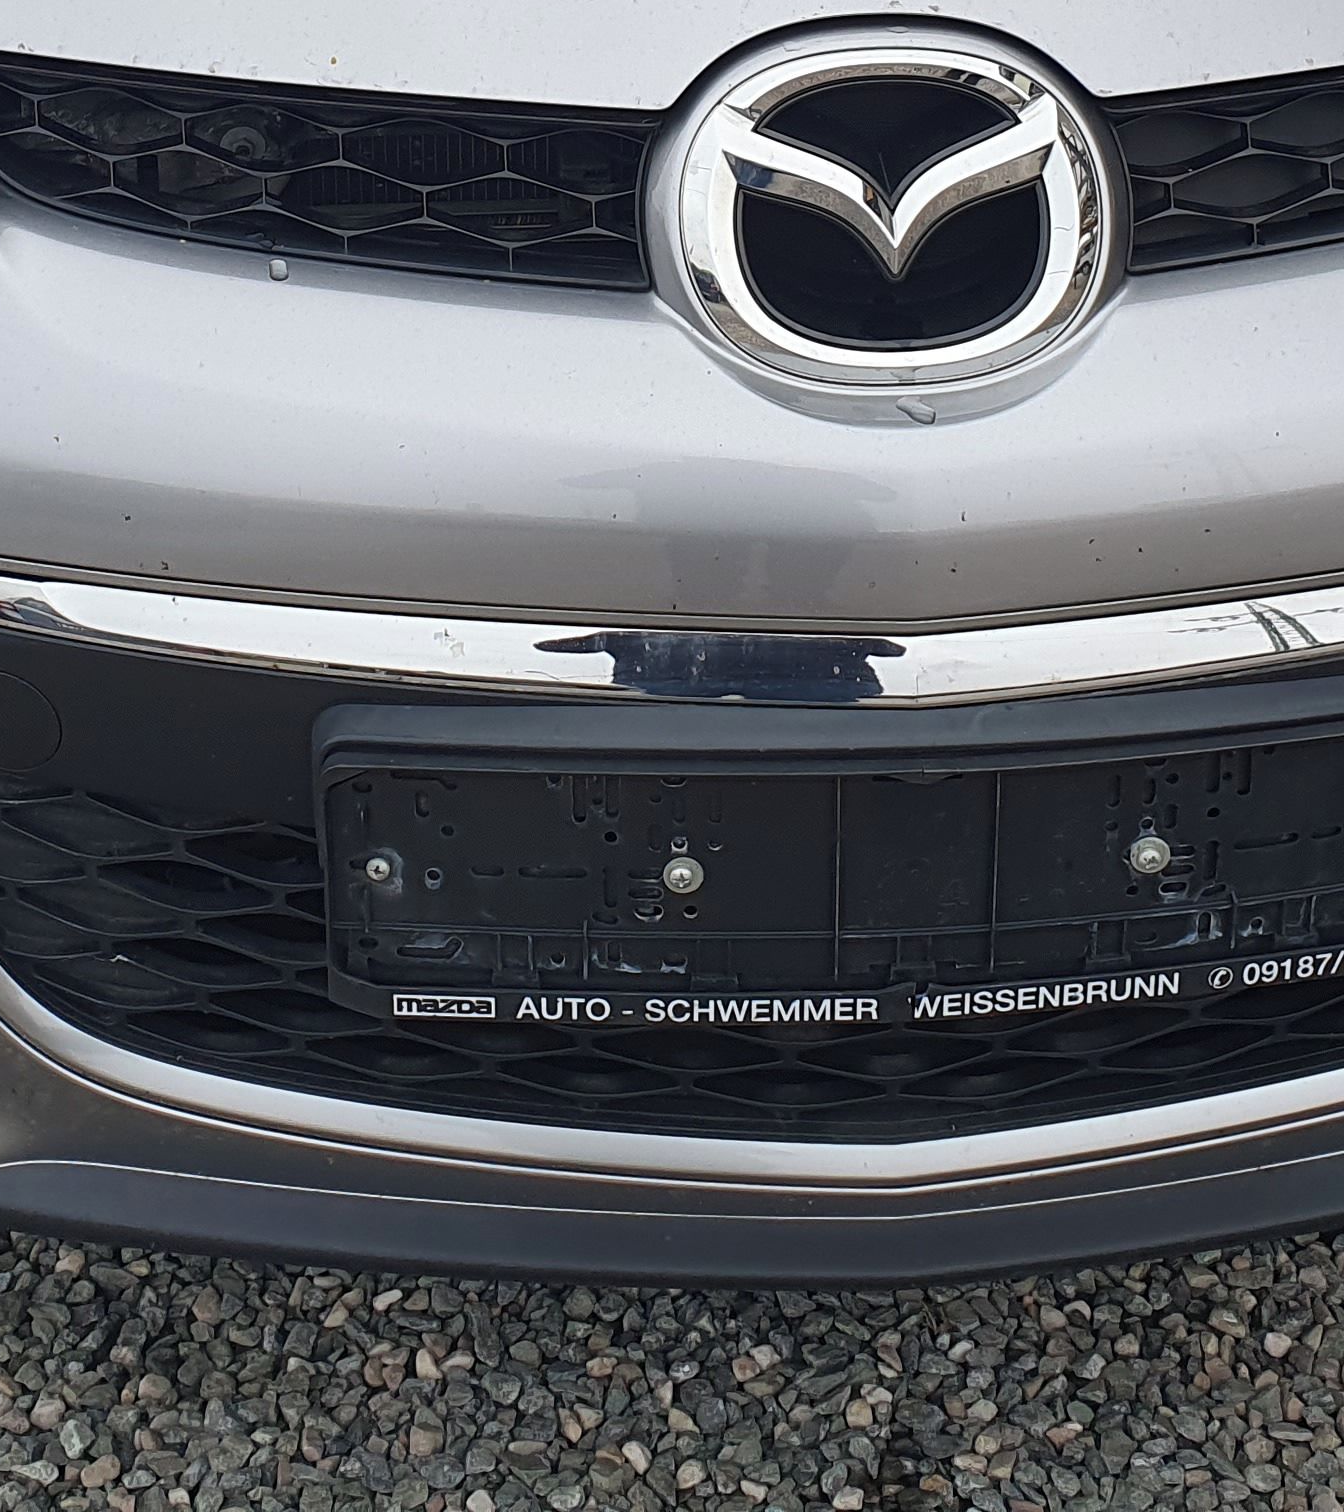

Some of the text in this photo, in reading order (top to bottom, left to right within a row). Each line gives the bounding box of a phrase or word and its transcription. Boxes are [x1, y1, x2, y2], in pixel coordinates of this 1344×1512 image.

[394, 995, 495, 1017] mazda
[516, 996, 611, 1022] AUTO
[644, 998, 878, 1023] SCHWEMMER
[909, 972, 1180, 1019] WEISSENBRUNN
